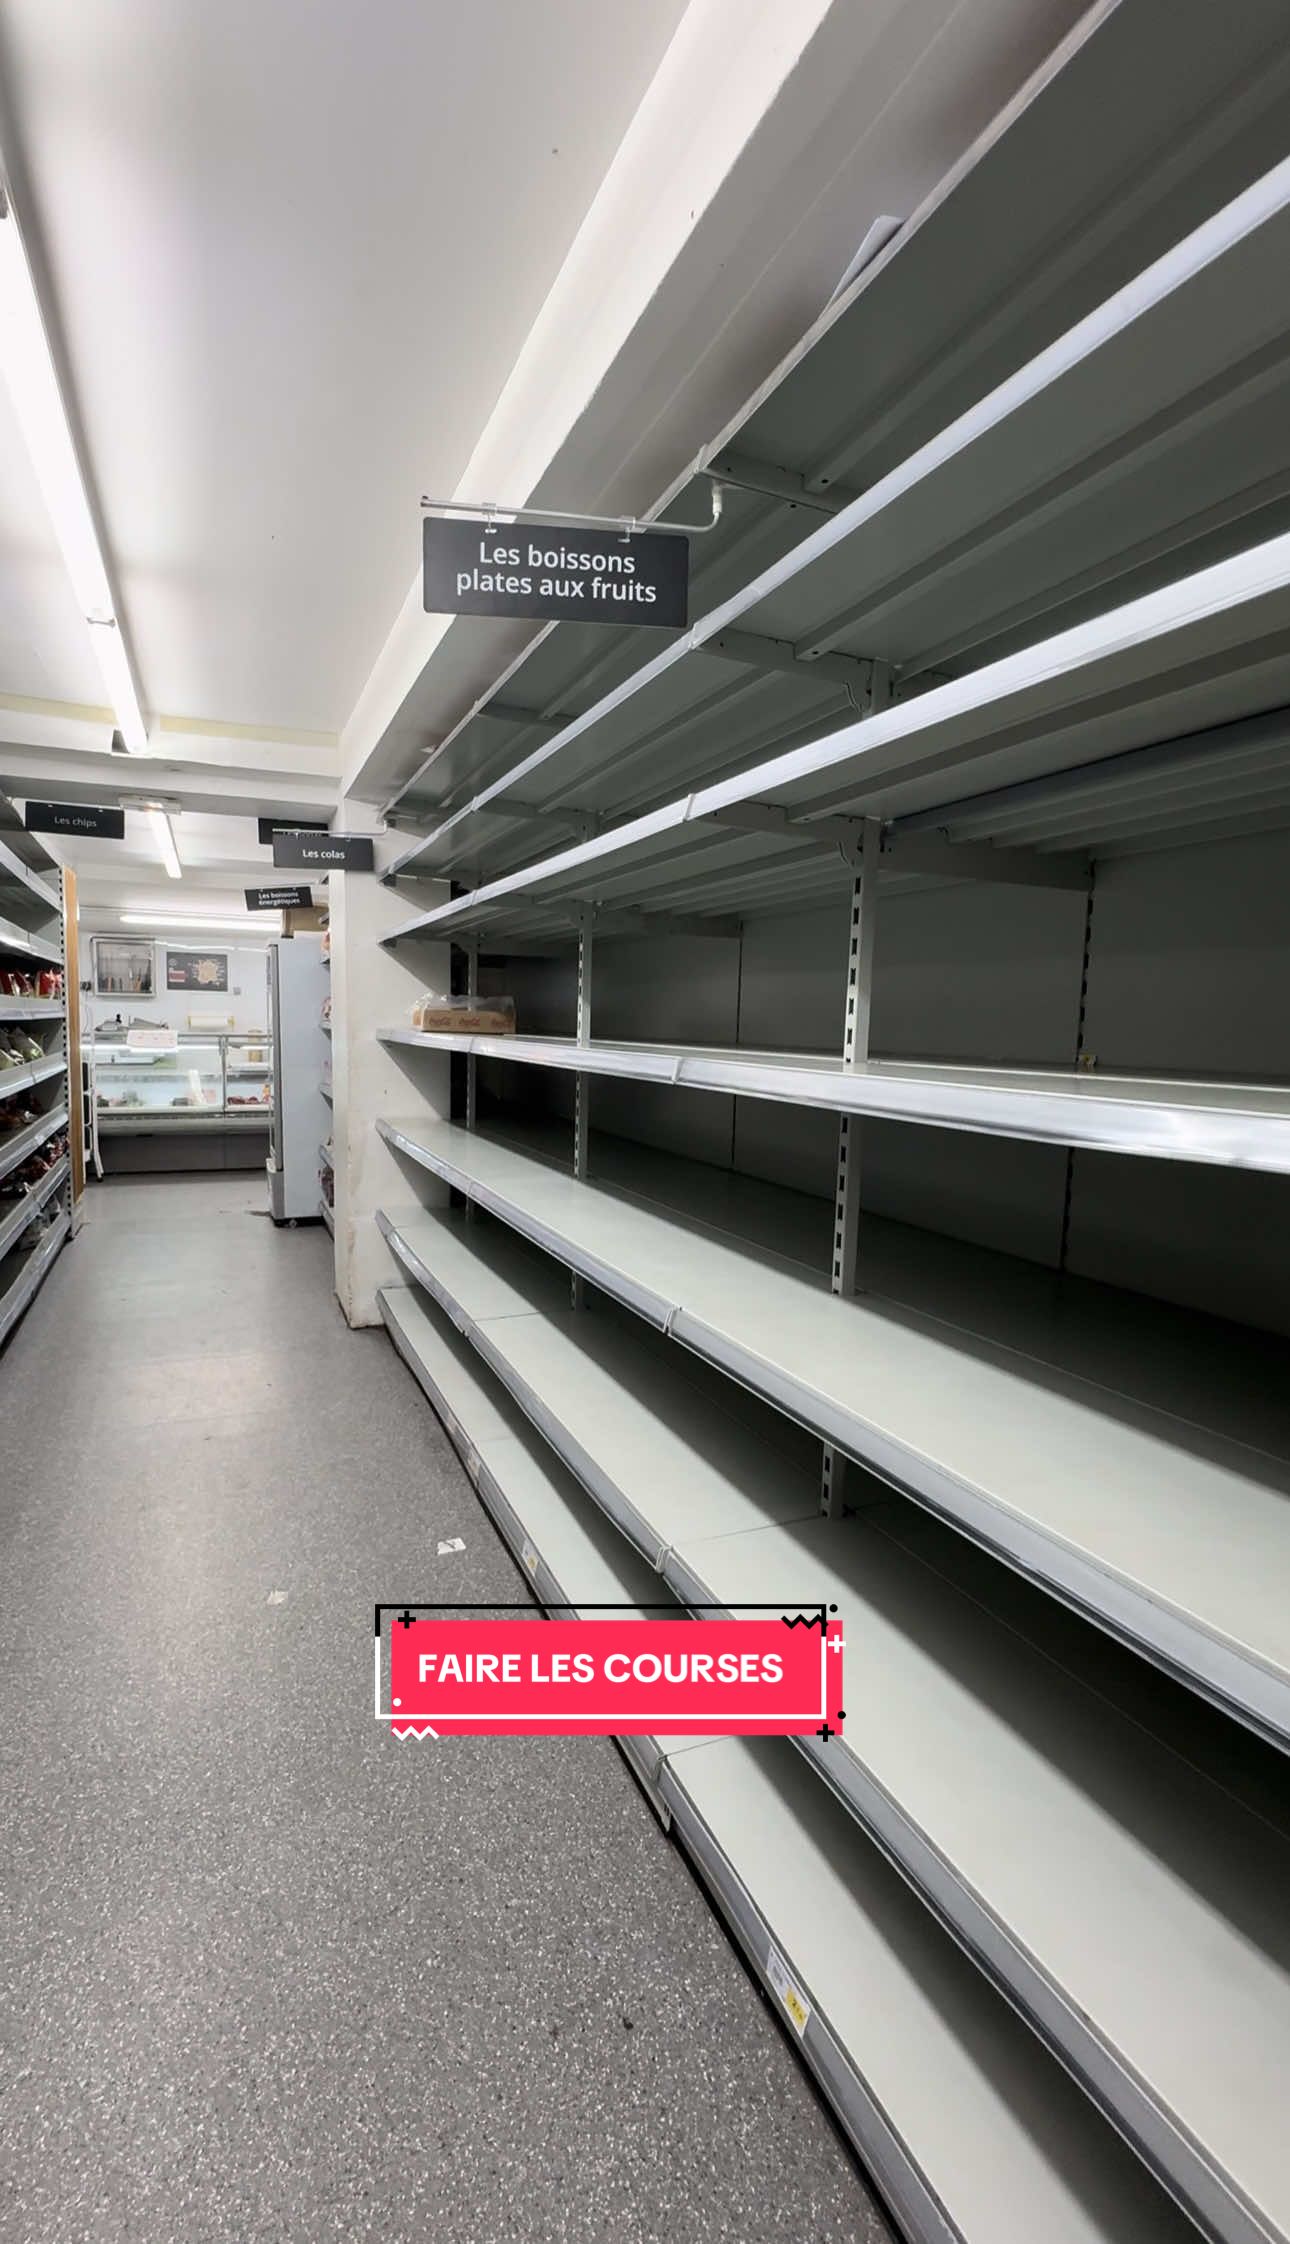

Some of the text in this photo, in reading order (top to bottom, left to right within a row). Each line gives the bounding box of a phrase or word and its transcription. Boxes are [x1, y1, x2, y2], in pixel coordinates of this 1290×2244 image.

[479, 541, 636, 574] Les boissons
[456, 569, 658, 603] plates aux fruits
[54, 816, 97, 829] Les chips
[302, 849, 346, 860] Les colas
